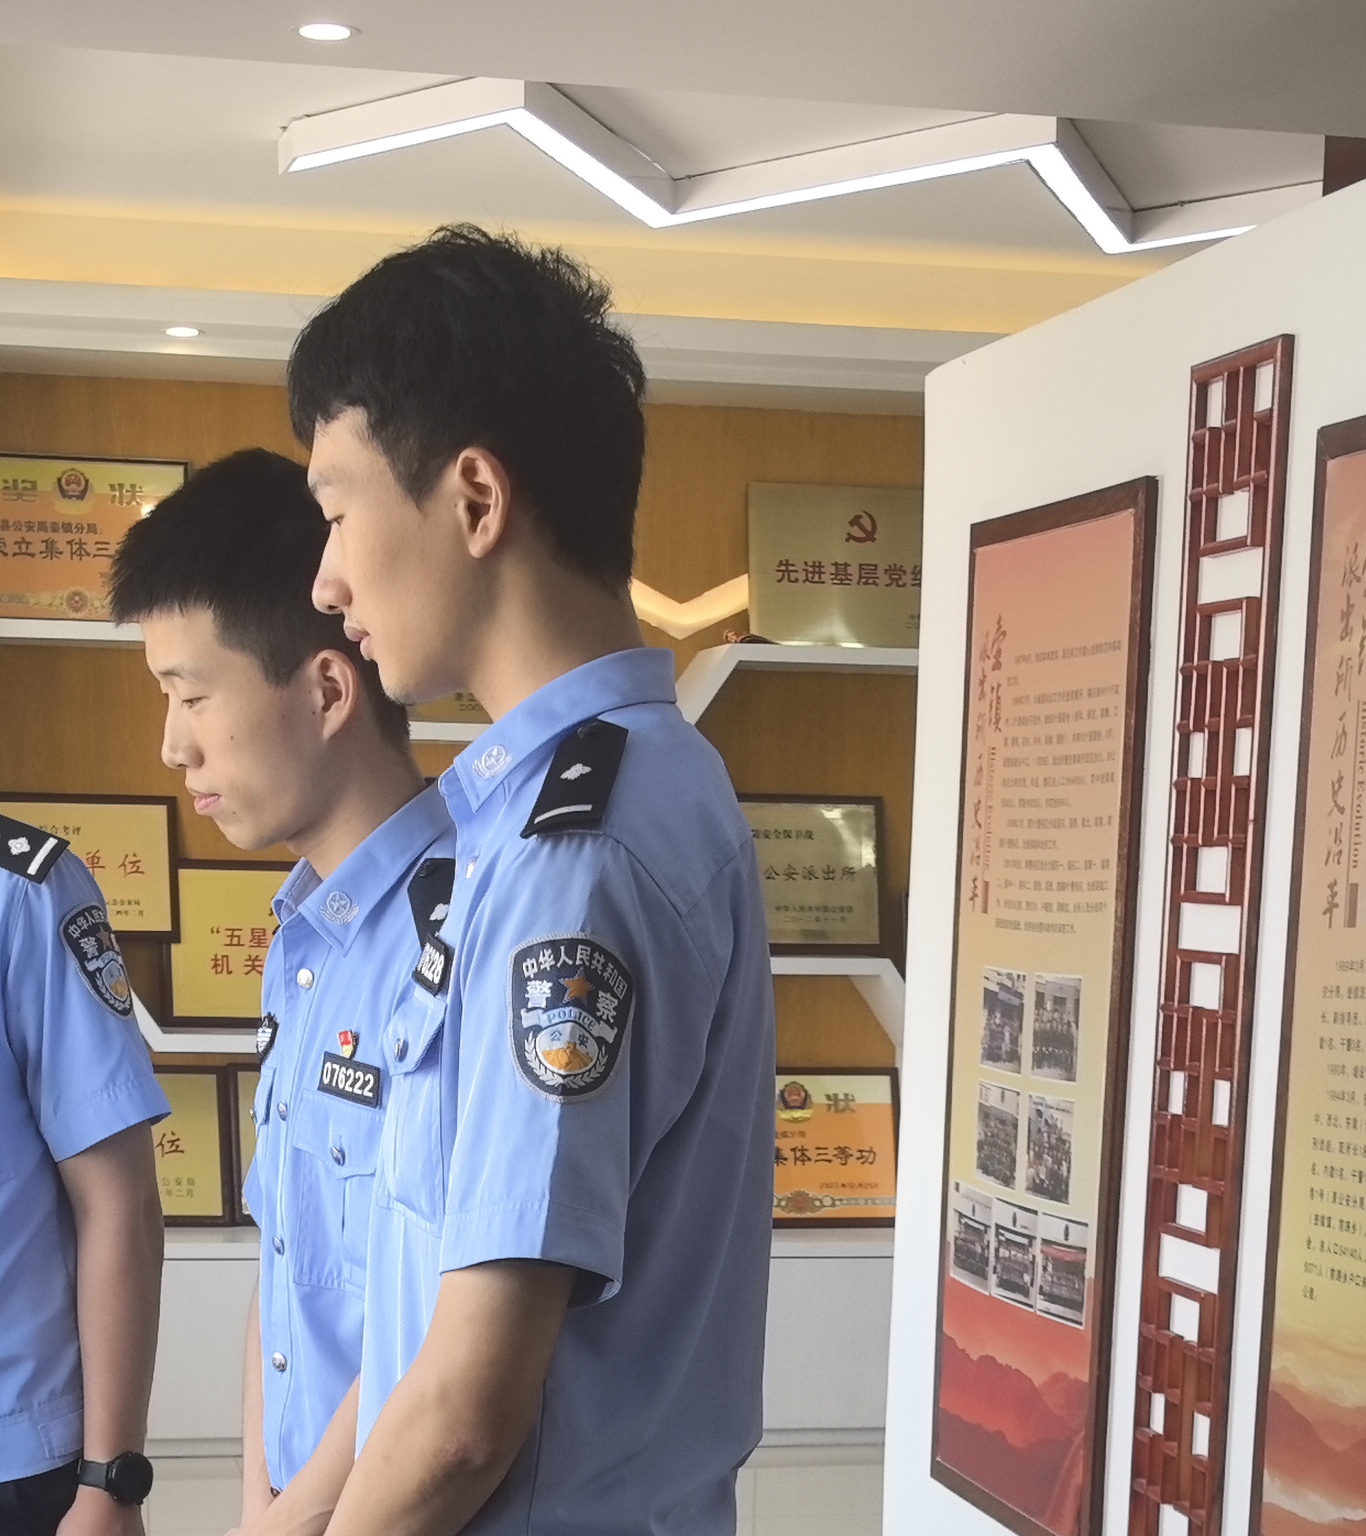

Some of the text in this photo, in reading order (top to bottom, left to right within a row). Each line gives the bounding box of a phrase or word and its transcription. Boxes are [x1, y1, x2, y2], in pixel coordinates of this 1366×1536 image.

[2, 478, 144, 506] 奖 状
[522, 944, 628, 1000] 中华人民共和国
[525, 979, 619, 1023] 警 察
[546, 1008, 597, 1033] POLICE
[323, 1061, 375, 1097] 076222
[825, 1093, 856, 1113] 状
[154, 1130, 185, 1159] 位
